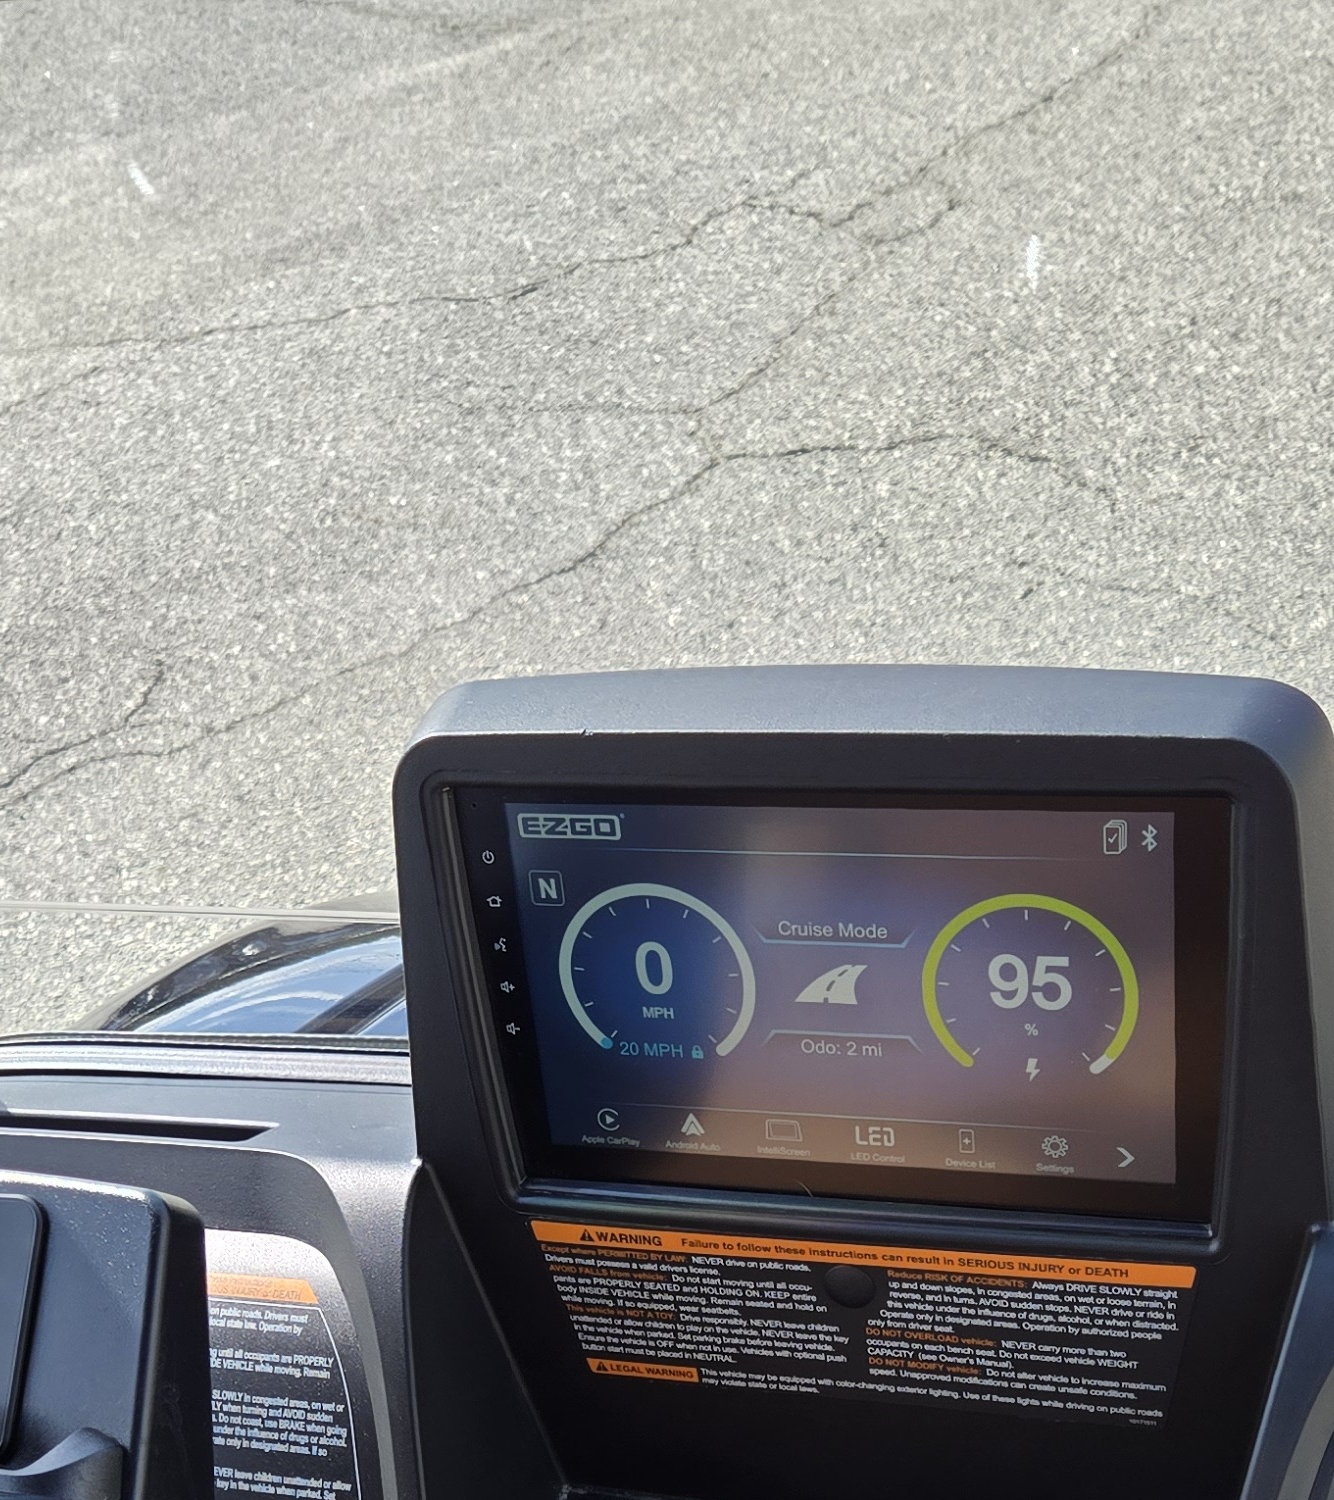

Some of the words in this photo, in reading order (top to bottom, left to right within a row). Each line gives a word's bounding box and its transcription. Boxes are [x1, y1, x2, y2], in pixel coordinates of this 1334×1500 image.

[538, 878, 557, 898] N
[778, 920, 834, 938] Cruise
[839, 922, 888, 939] Mode
[635, 941, 673, 995] 0
[988, 953, 1072, 1010] 95
[642, 1006, 674, 1019] MPH
[1024, 1023, 1038, 1036] %
[620, 1042, 640, 1056] 20
[644, 1042, 684, 1058] MPH
[801, 1038, 841, 1055] Odo:
[847, 1041, 858, 1056] 2
[862, 1043, 882, 1057] mi
[582, 1135, 605, 1145] Apple
[607, 1136, 641, 1147] CarPlay
[855, 1125, 895, 1147] LED
[665, 1140, 698, 1151] Android
[700, 1142, 721, 1152] Auto
[851, 1152, 870, 1162] LED
[872, 1153, 905, 1163] Control
[945, 1157, 978, 1168] Device
[979, 1159, 996, 1170] List
[1036, 1162, 1075, 1174] Settings
[595, 1231, 662, 1246] WARNING
[681, 1238, 719, 1249] Failure
[723, 1242, 734, 1250] to
[737, 1242, 771, 1253] follow
[775, 1245, 805, 1255] these
[809, 1247, 877, 1260] instructions
[881, 1254, 903, 1262] can
[907, 1255, 939, 1265] result
[943, 1256, 955, 1266] in
[957, 1257, 1015, 1270] SERIOUS
[1017, 1262, 1065, 1274] INJURY
[1069, 1267, 1081, 1275] or
[1085, 1266, 1129, 1278] DEATH
[691, 1255, 725, 1265] NEVER
[725, 1258, 746, 1267] drive
[759, 1261, 785, 1270] public
[785, 1263, 811, 1272] roads.
[593, 1278, 641, 1288] PROPERLY
[643, 1281, 681, 1291] SEATED
[682, 1285, 697, 1293] and
[699, 1286, 743, 1296] HOLDING
[764, 1291, 791, 1300] KEEP
[792, 1294, 817, 1302] entire
[671, 1273, 685, 1281] Do
[723, 1278, 755, 1288] moving
[924, 1272, 947, 1281] RISK
[950, 1274, 963, 1283] OF
[1032, 1280, 1065, 1292] Always
[1066, 1282, 1097, 1293] DRIVE
[1098, 1285, 1143, 1296] SLOWLY
[1143, 1289, 1178, 1300] straight
[557, 1284, 577, 1295] body
[579, 1285, 609, 1296] INSIDE
[610, 1288, 650, 1299] VEHICLE
[651, 1291, 674, 1301] while
[710, 1296, 744, 1306] Remain
[745, 1300, 775, 1309] seated
[777, 1302, 793, 1310] and
[794, 1302, 814, 1312] hold
[219, 1307, 241, 1319] public
[264, 1310, 289, 1322] Drivers
[290, 1315, 309, 1324] must
[865, 1328, 880, 1336] DO
[882, 1329, 902, 1338] NOT
[904, 1331, 958, 1343] OVERLOAD
[1001, 1339, 1037, 1350] NEVER
[1037, 1344, 1061, 1354] carry
[1062, 1347, 1086, 1355] more
[1087, 1347, 1107, 1357] than
[1109, 1350, 1127, 1358] two
[218, 1348, 234, 1358] until
[234, 1348, 243, 1359] all
[244, 1352, 280, 1364] occupants
[281, 1355, 292, 1364] are
[293, 1353, 335, 1368] PROPERLY
[866, 1340, 909, 1349] occupants
[924, 1344, 946, 1352] each
[947, 1345, 974, 1355] bench
[999, 1350, 1012, 1358] Do
[1013, 1352, 1029, 1360] not
[1029, 1354, 1062, 1363] exceed
[1063, 1356, 1095, 1366] vehicle
[1096, 1358, 1139, 1369] WEIGHT
[867, 1347, 914, 1359] CAPACITY
[917, 1352, 937, 1362] (see
[939, 1354, 975, 1365] Owner's
[223, 1358, 254, 1371] VEHICLE
[255, 1362, 273, 1373] while
[303, 1367, 331, 1379] Remain
[610, 1363, 644, 1374] LEGAL
[647, 1366, 694, 1378] WARNING
[211, 1389, 243, 1402] SLOWLY
[243, 1392, 251, 1403] in
[251, 1395, 289, 1407] congested
[311, 1402, 321, 1410] on
[321, 1402, 335, 1412] wet
[335, 1404, 345, 1413] or
